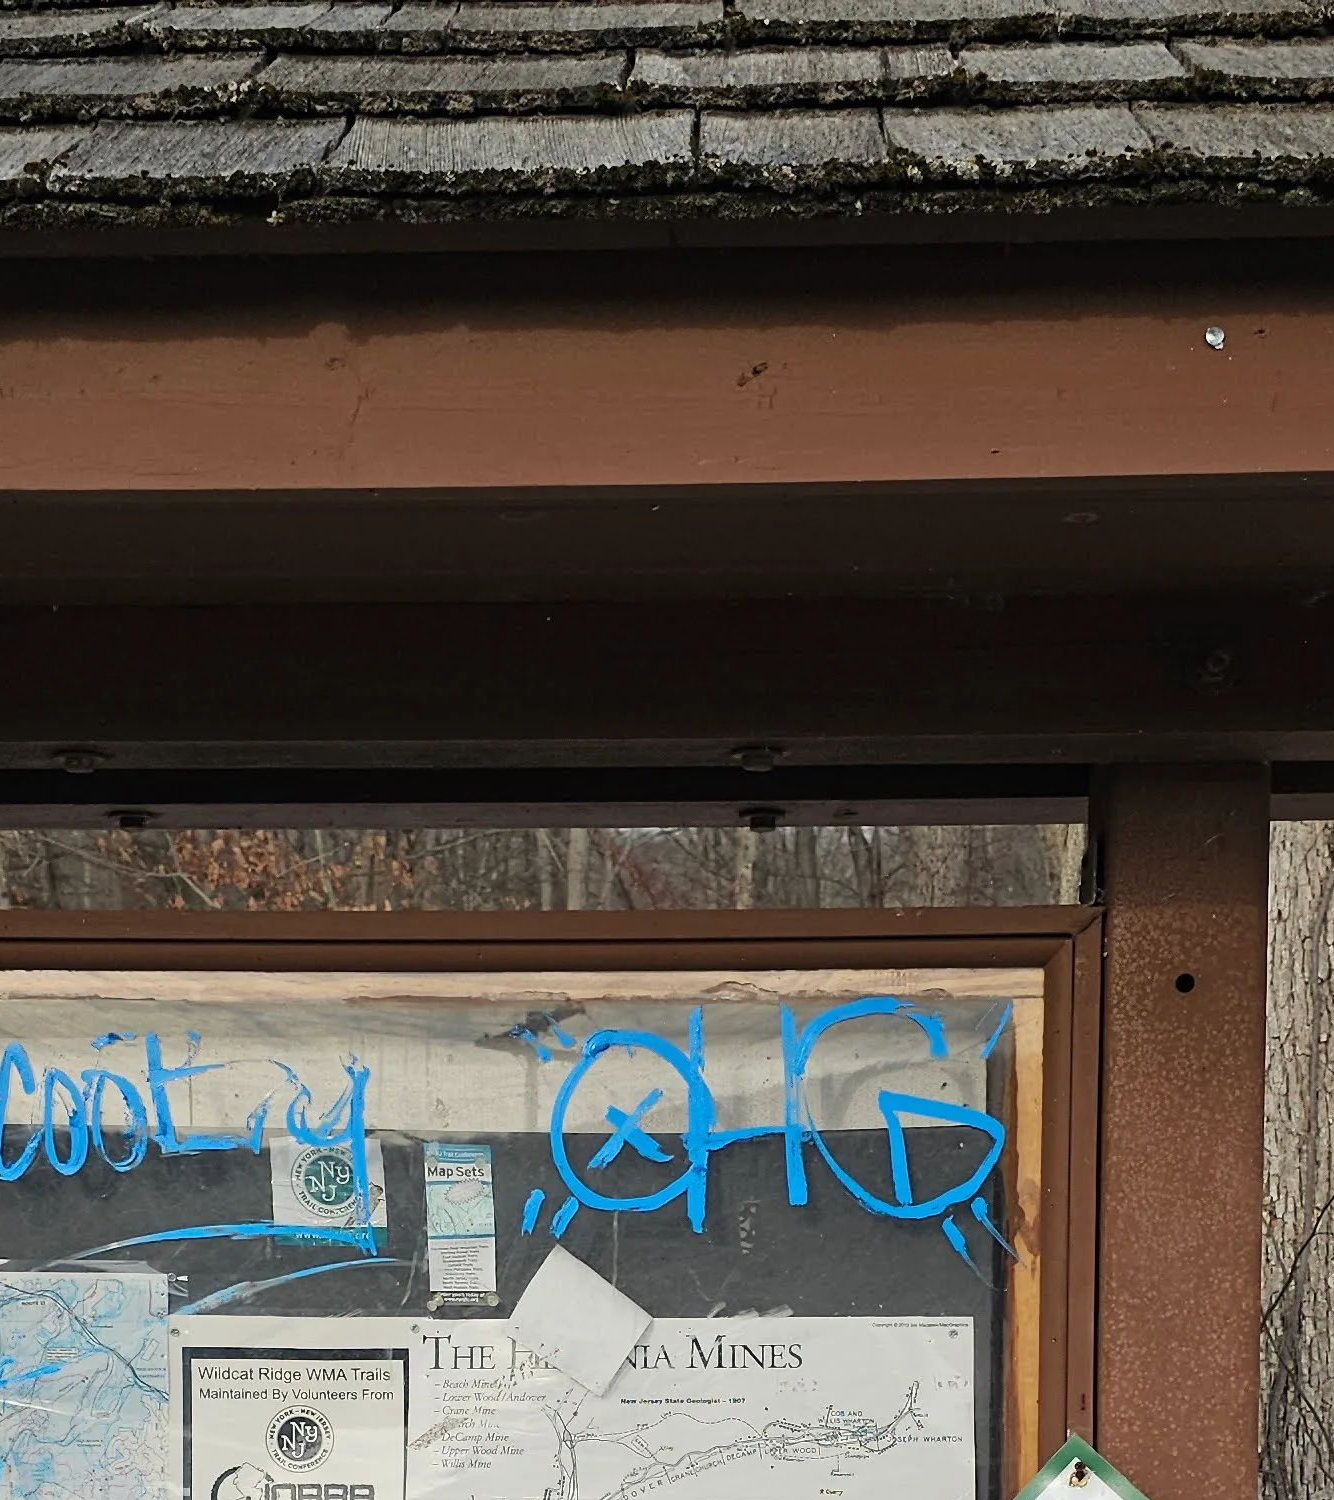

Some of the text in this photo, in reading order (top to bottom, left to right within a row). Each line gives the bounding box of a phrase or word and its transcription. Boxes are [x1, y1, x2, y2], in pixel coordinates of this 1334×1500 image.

[427, 1165, 485, 1178] Map Sets
[423, 1334, 496, 1370] THE
[685, 1334, 804, 1370] MINES
[197, 1366, 392, 1384] Wildcat Ridge WMA Trails
[442, 1379, 495, 1389] Beach Mine
[199, 1387, 395, 1403] Maintained By Volunteers From
[442, 1392, 471, 1402] Lower
[638, 1398, 663, 1406] Jersey
[686, 1398, 721, 1406] Geologist
[442, 1405, 496, 1415] Crane Mine
[268, 1408, 332, 1440] NEW YORK NEW JERSEY
[441, 1432, 509, 1444] DeCamp Mine
[442, 1445, 524, 1457] Upper Wood Mine
[271, 1448, 329, 1470] TRAIL CONFERENCE
[441, 1459, 492, 1469] Willis Mine
